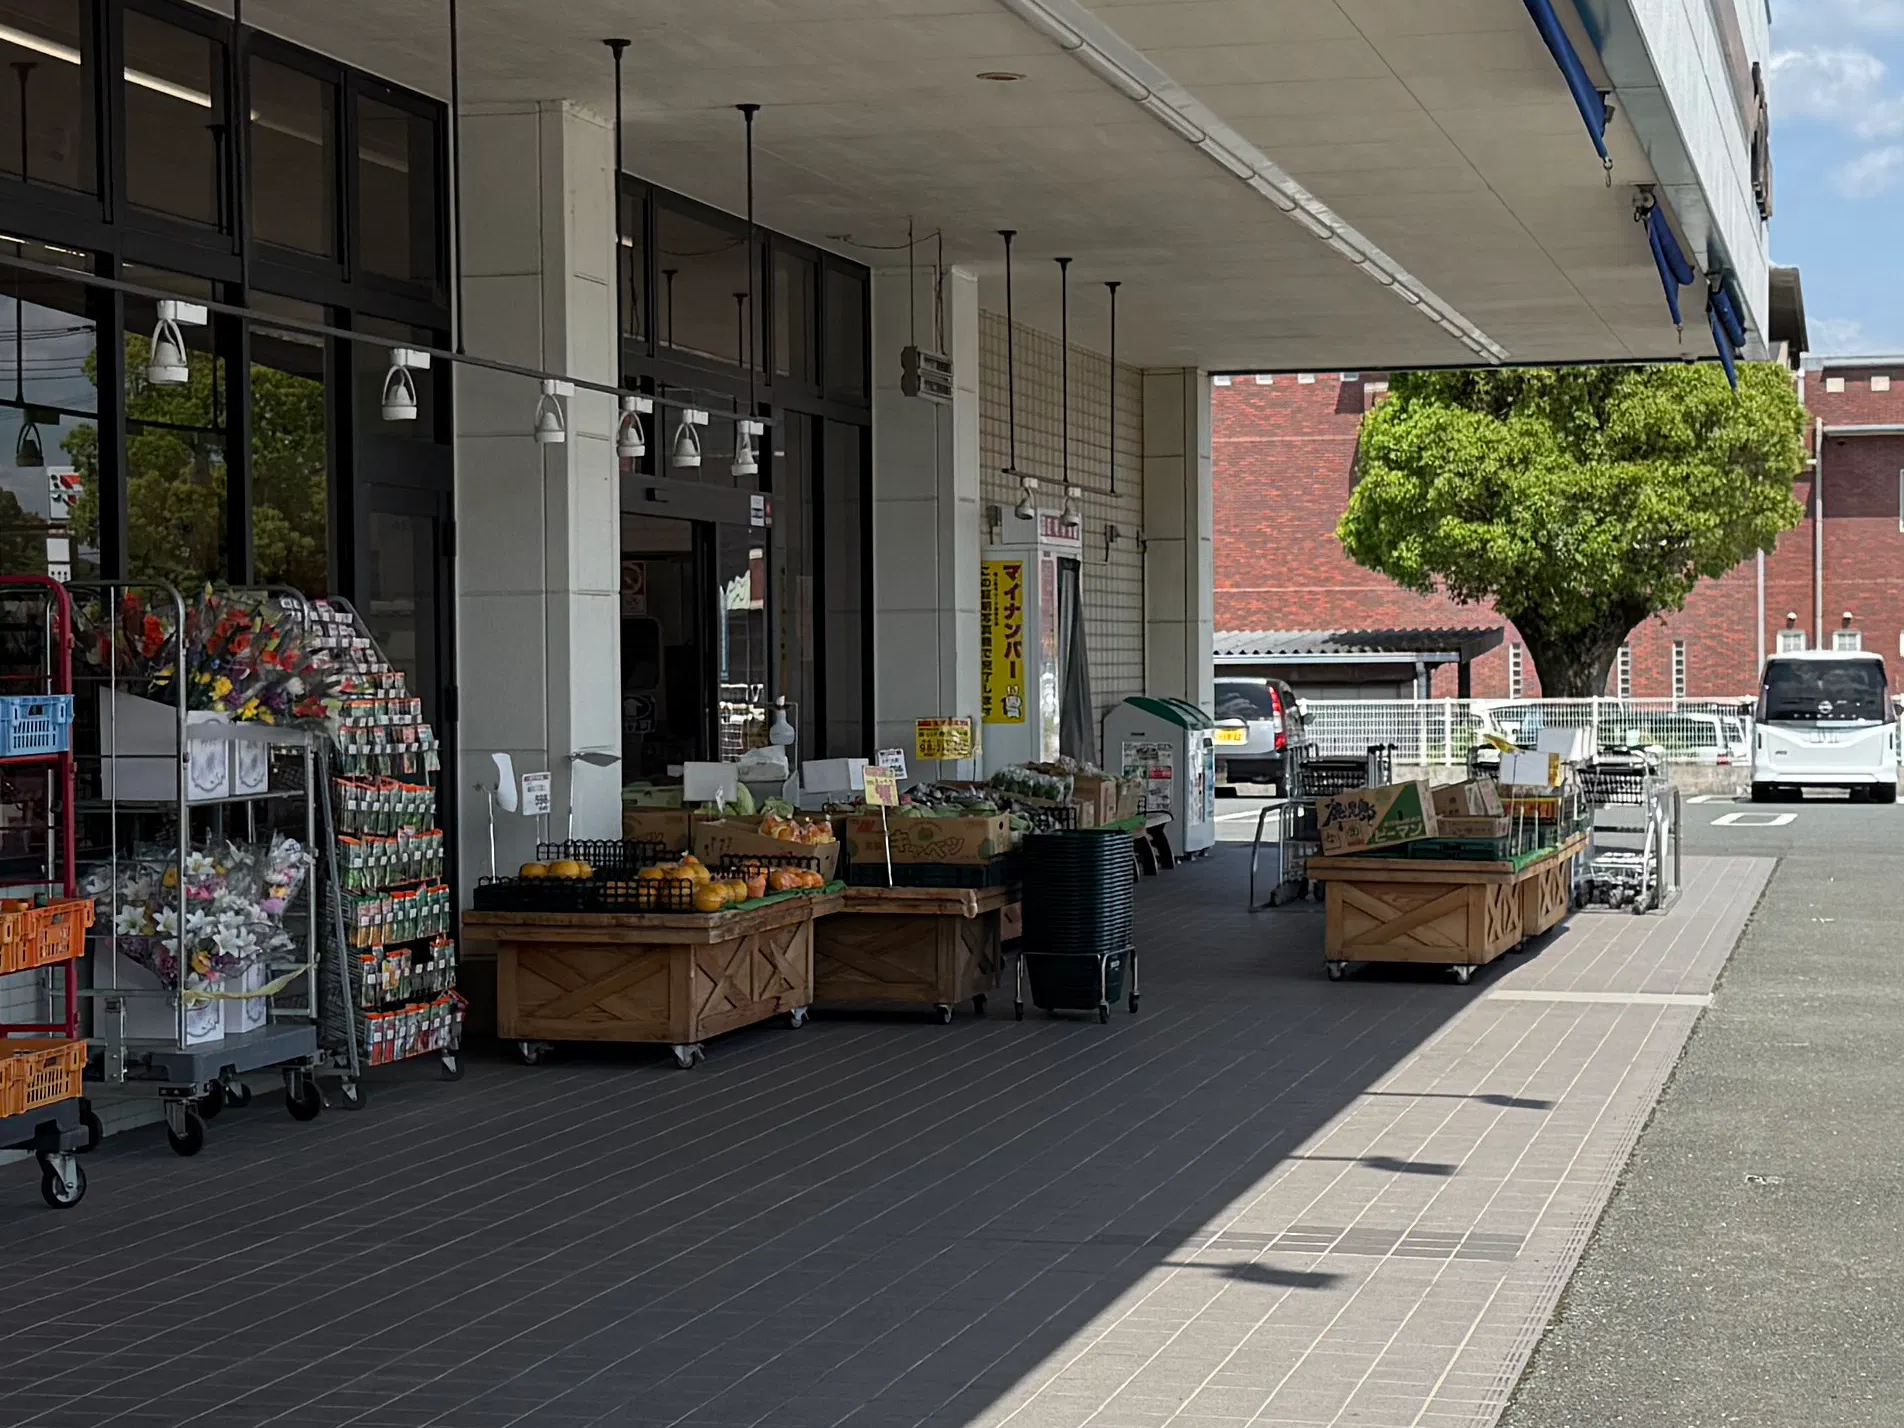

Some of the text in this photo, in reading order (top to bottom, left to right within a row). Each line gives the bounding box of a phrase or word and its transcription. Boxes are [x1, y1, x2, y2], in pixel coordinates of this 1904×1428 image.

[1003, 565, 1023, 679] マイナンバー
[890, 829, 966, 860] キャベツ
